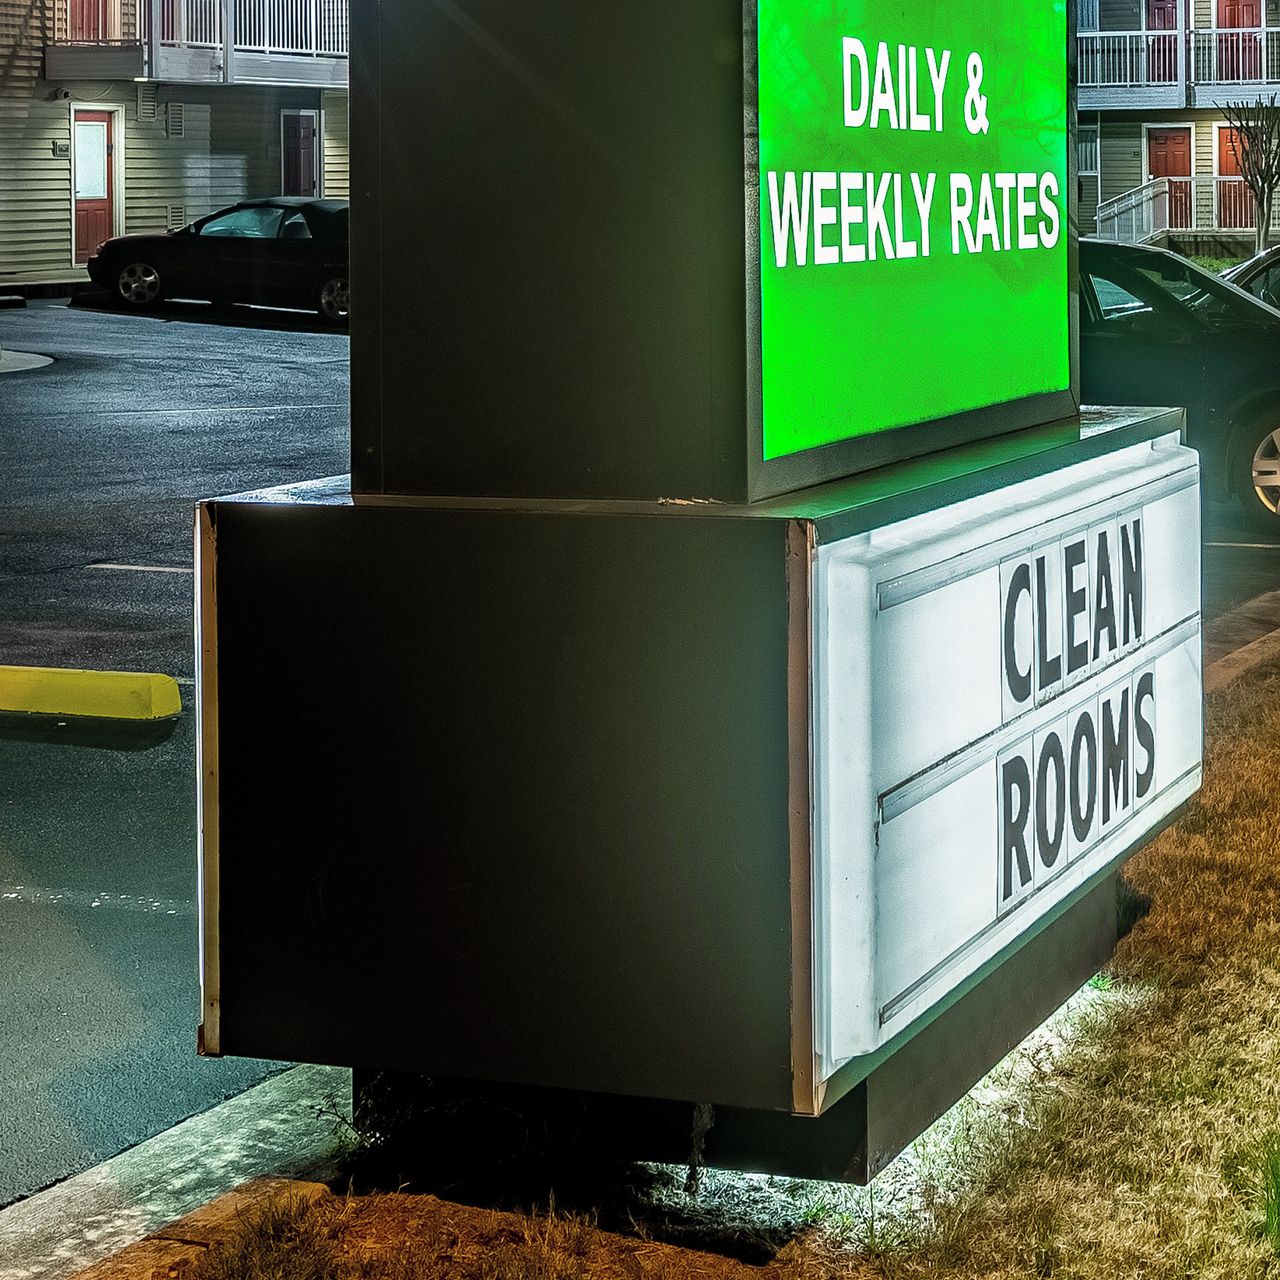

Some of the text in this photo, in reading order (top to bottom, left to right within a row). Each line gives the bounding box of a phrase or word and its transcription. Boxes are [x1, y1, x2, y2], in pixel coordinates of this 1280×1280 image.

[842, 36, 990, 135] DAILY &
[767, 171, 1060, 268] WEEKLY RATES
[1004, 518, 1144, 703] CLEAN
[1001, 672, 1156, 903] ROOMS
